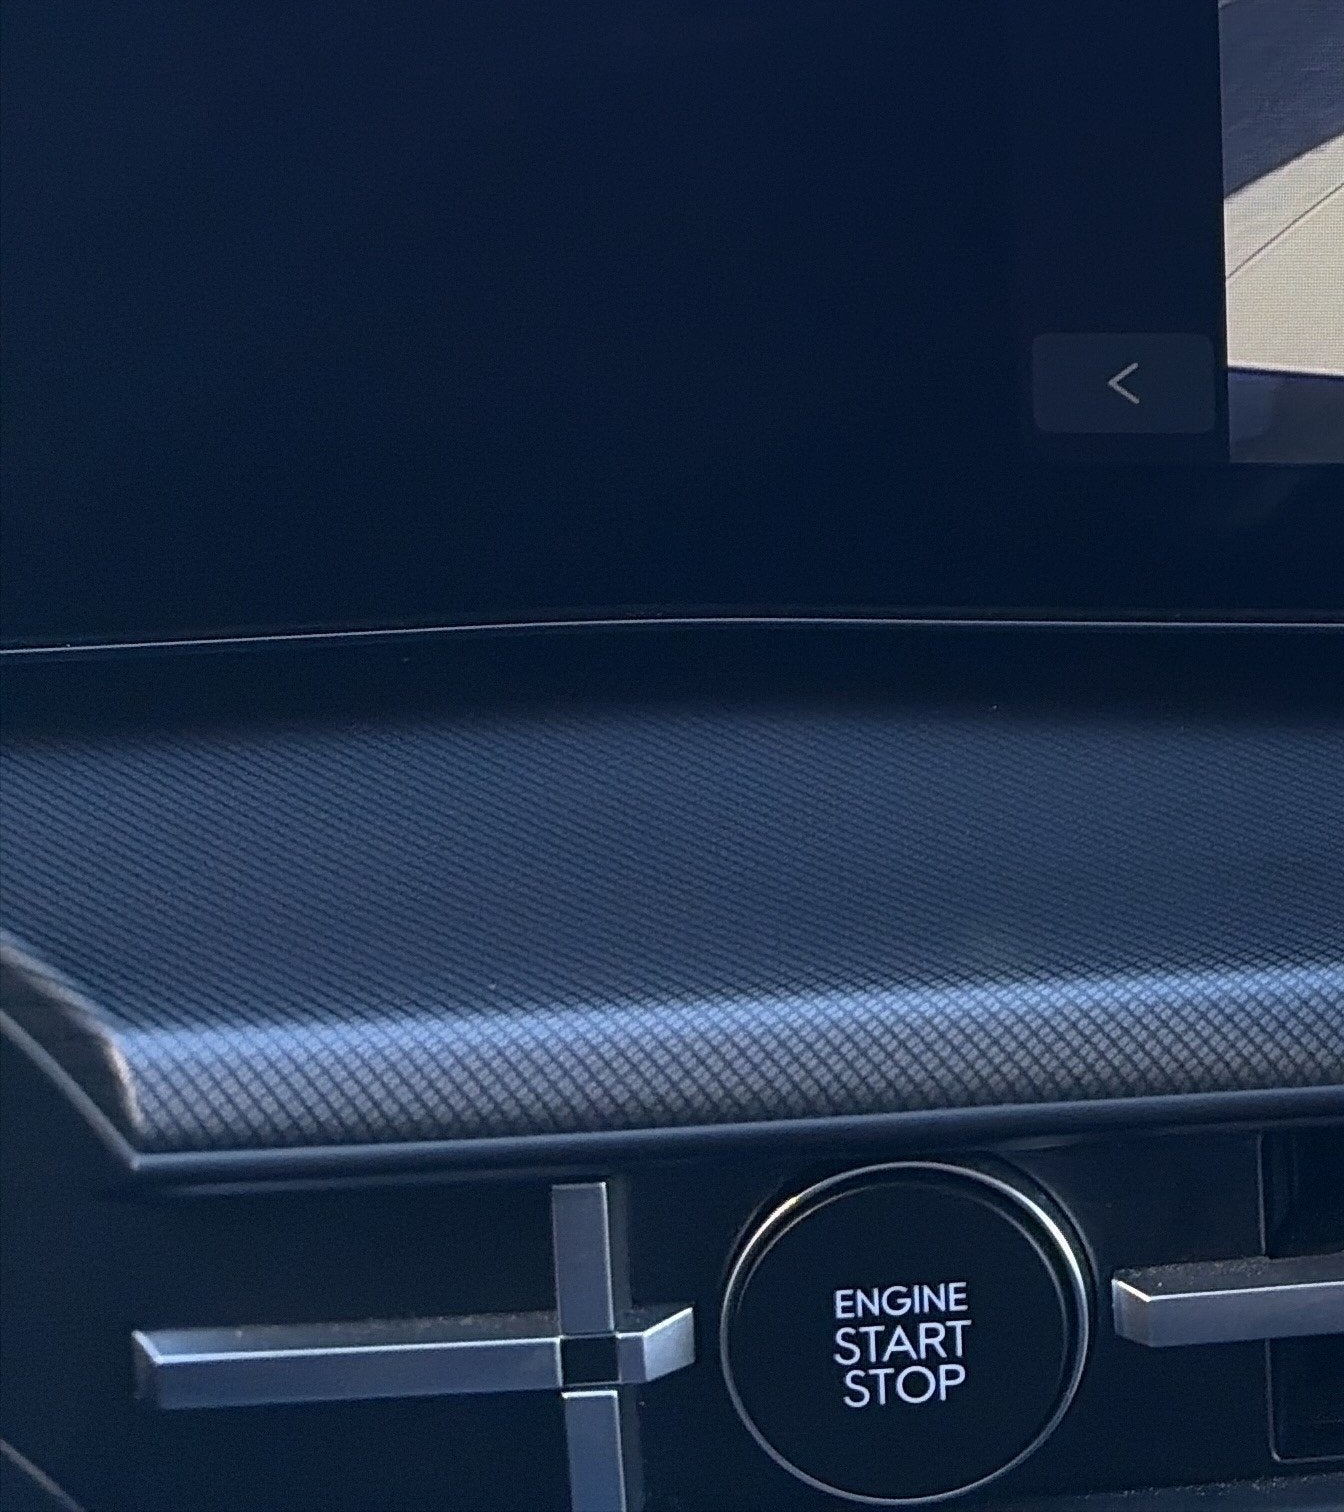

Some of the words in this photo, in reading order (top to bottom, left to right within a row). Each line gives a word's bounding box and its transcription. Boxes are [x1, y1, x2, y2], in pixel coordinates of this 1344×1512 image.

[834, 1282, 968, 1319] ENGINE
[834, 1320, 972, 1365] START
[844, 1364, 966, 1408] STOP
